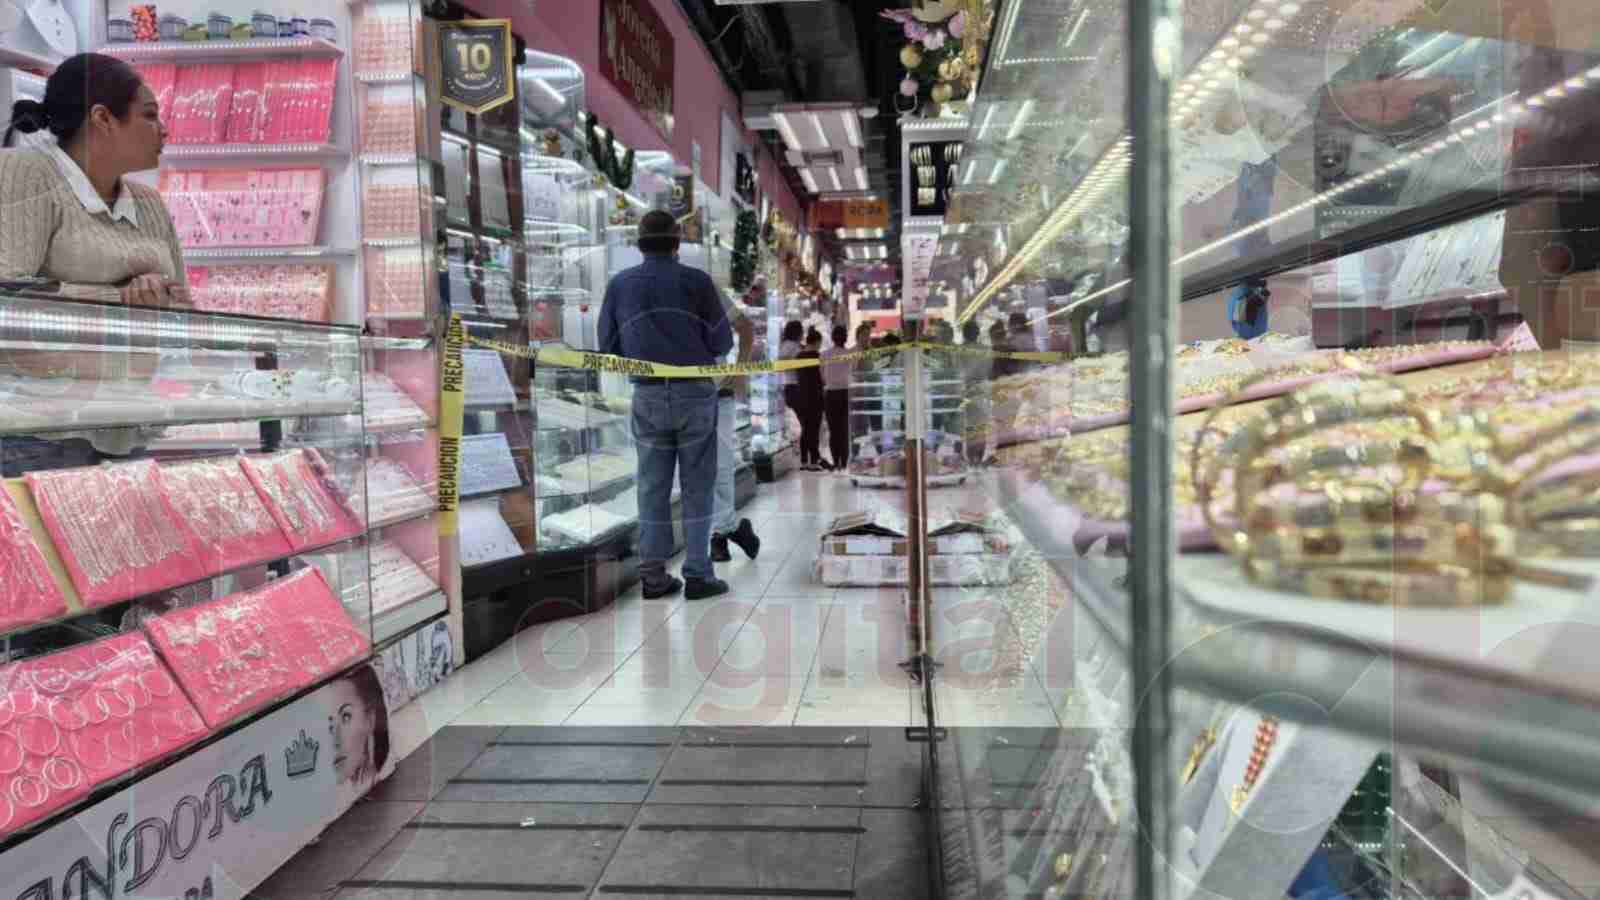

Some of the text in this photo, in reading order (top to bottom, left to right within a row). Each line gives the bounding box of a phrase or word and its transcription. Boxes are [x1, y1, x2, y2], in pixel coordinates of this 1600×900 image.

[456, 42, 491, 72] 10
[583, 353, 655, 376] PRECAUCION
[439, 437, 459, 512] PRECAUCION
